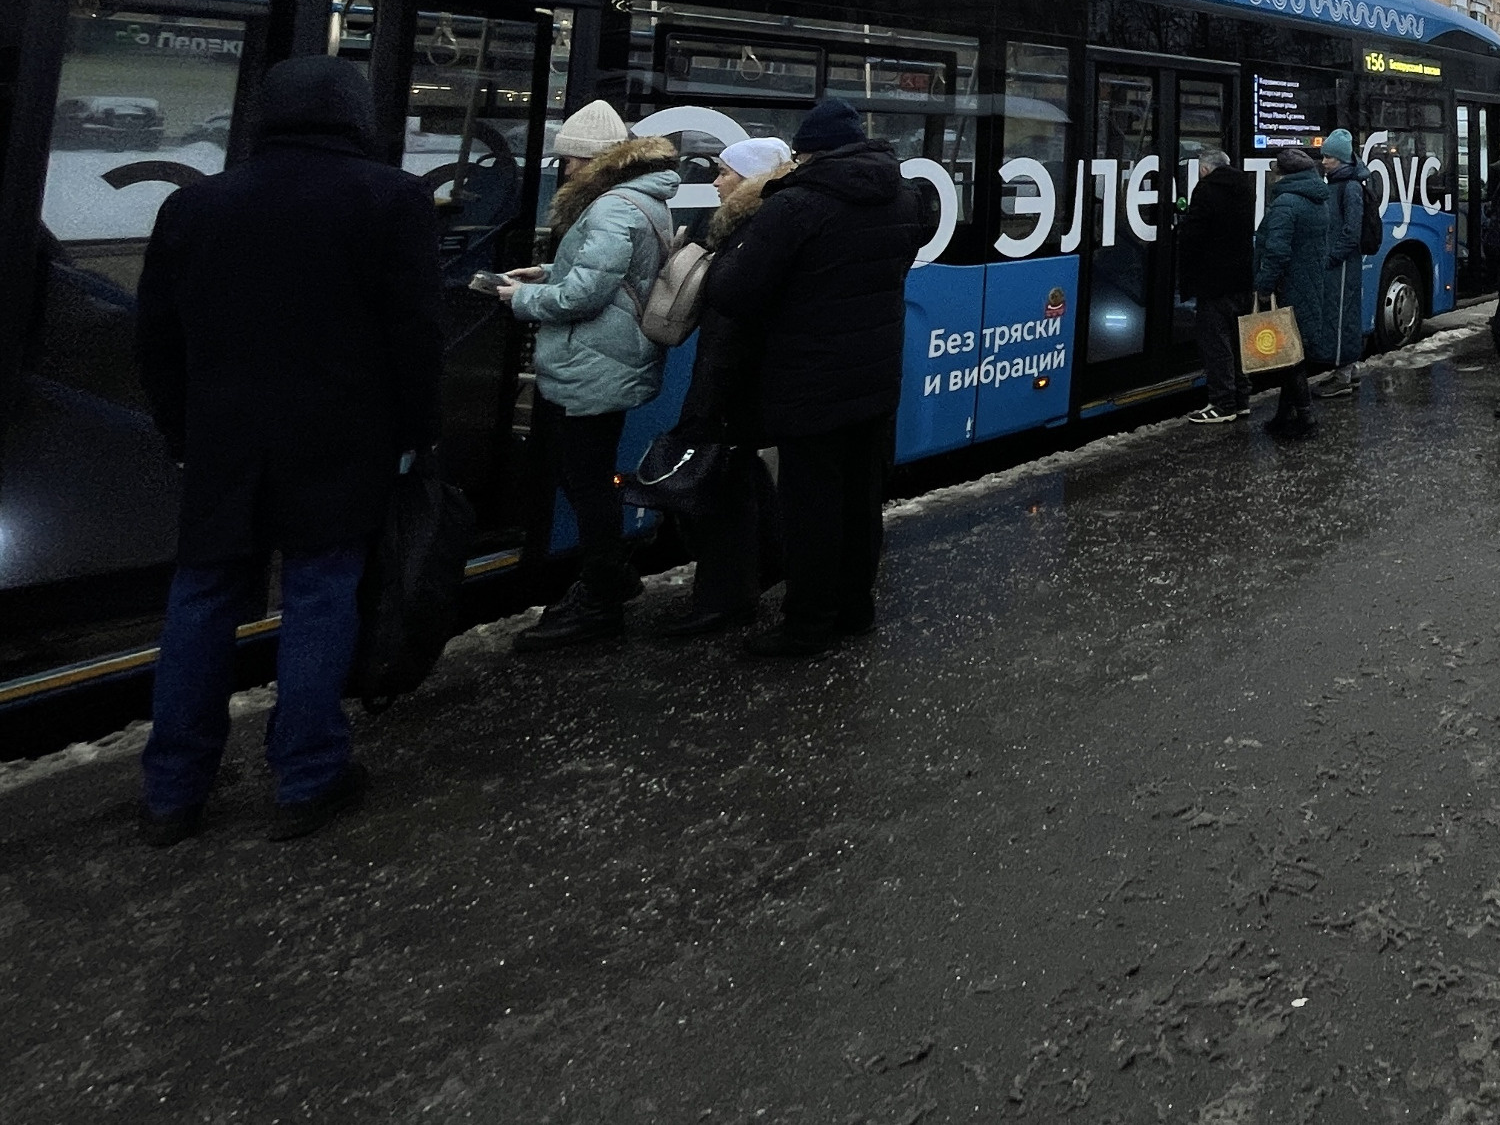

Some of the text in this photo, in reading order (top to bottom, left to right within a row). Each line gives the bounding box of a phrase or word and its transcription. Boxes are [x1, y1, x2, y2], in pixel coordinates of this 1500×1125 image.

[928, 316, 1061, 358] Без тряски
[923, 343, 1066, 396] и вибраций
